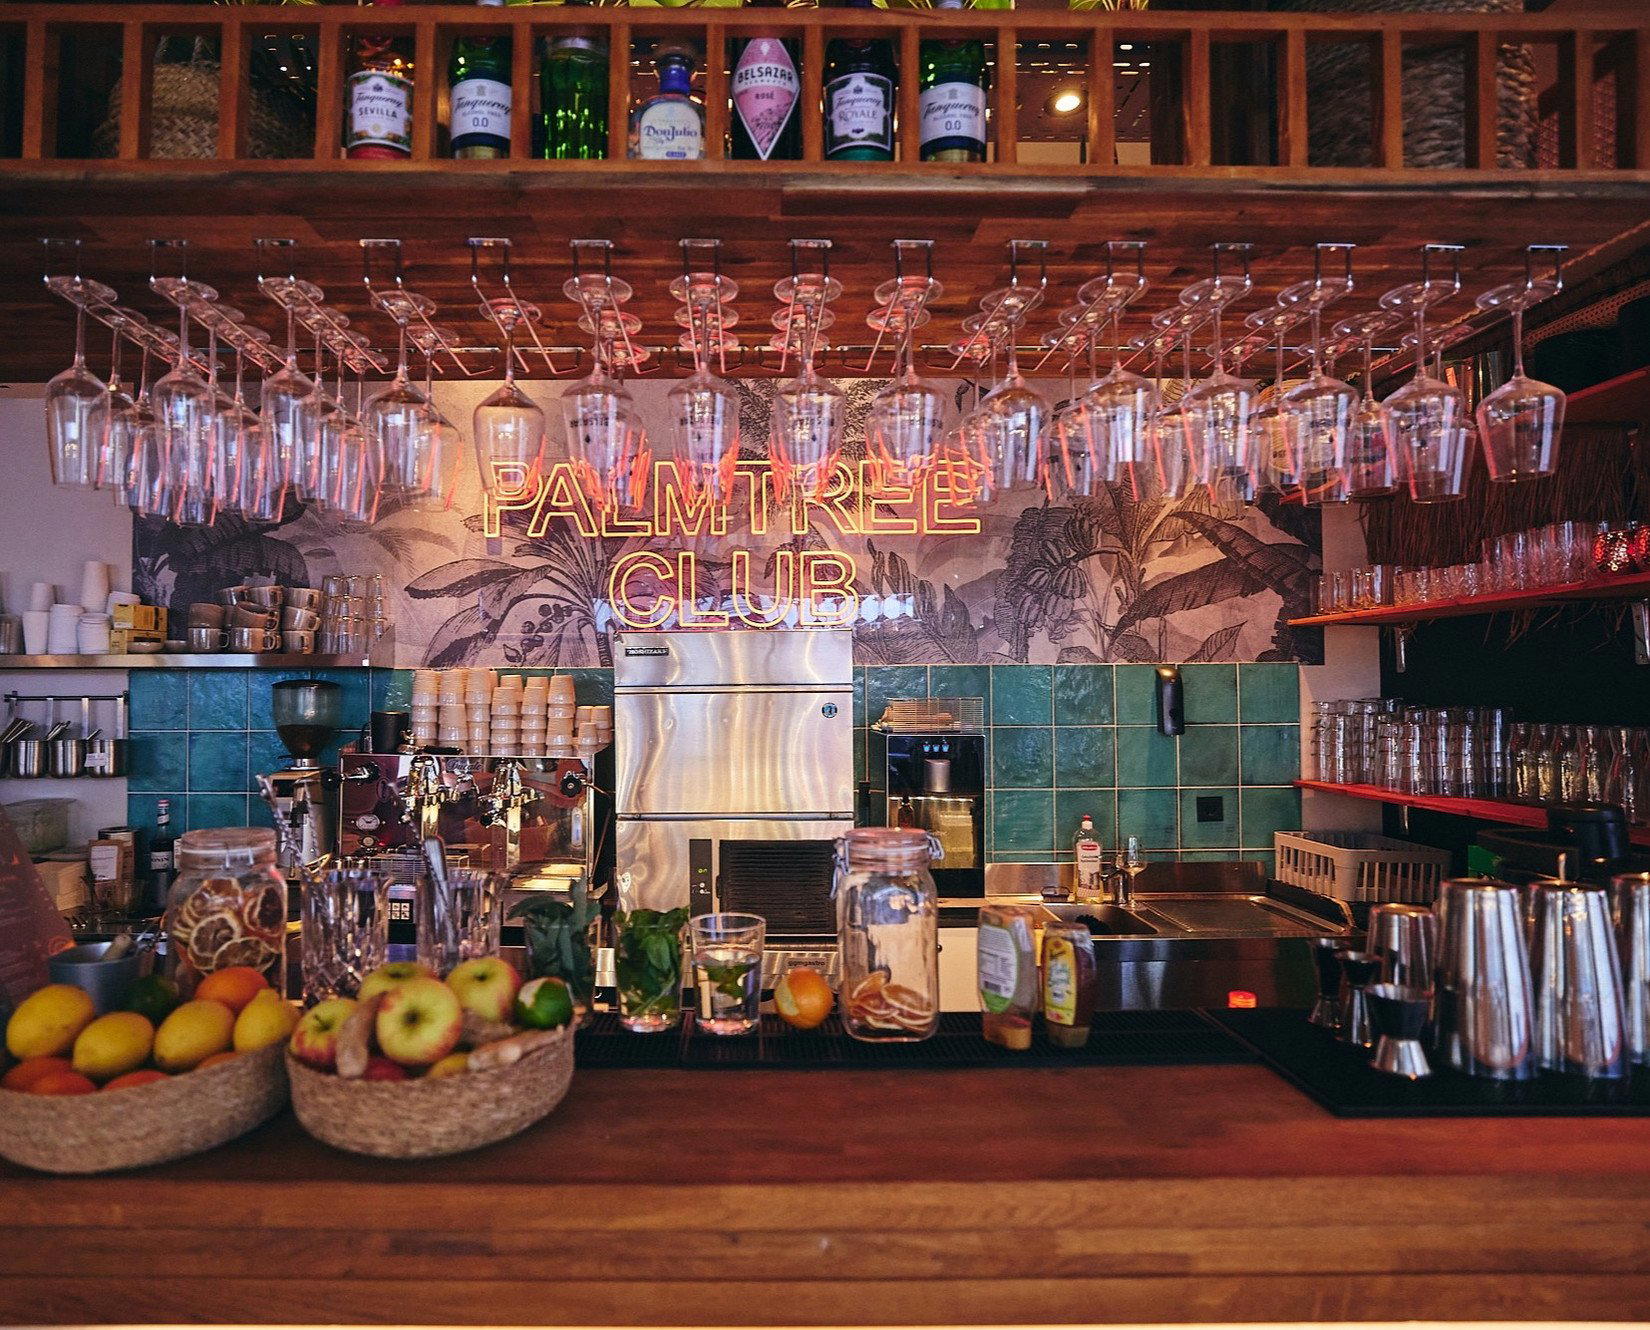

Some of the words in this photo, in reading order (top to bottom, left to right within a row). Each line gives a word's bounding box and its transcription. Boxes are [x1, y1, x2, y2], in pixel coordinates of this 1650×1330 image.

[738, 66, 793, 83] BELSAZAR
[355, 92, 403, 107] Tanqueray
[454, 97, 512, 114] Tanqueray
[358, 107, 398, 119] SEVILLA
[923, 101, 980, 119] Tanqueray
[484, 460, 981, 537] PALMTREE
[609, 551, 860, 629] CLUB
